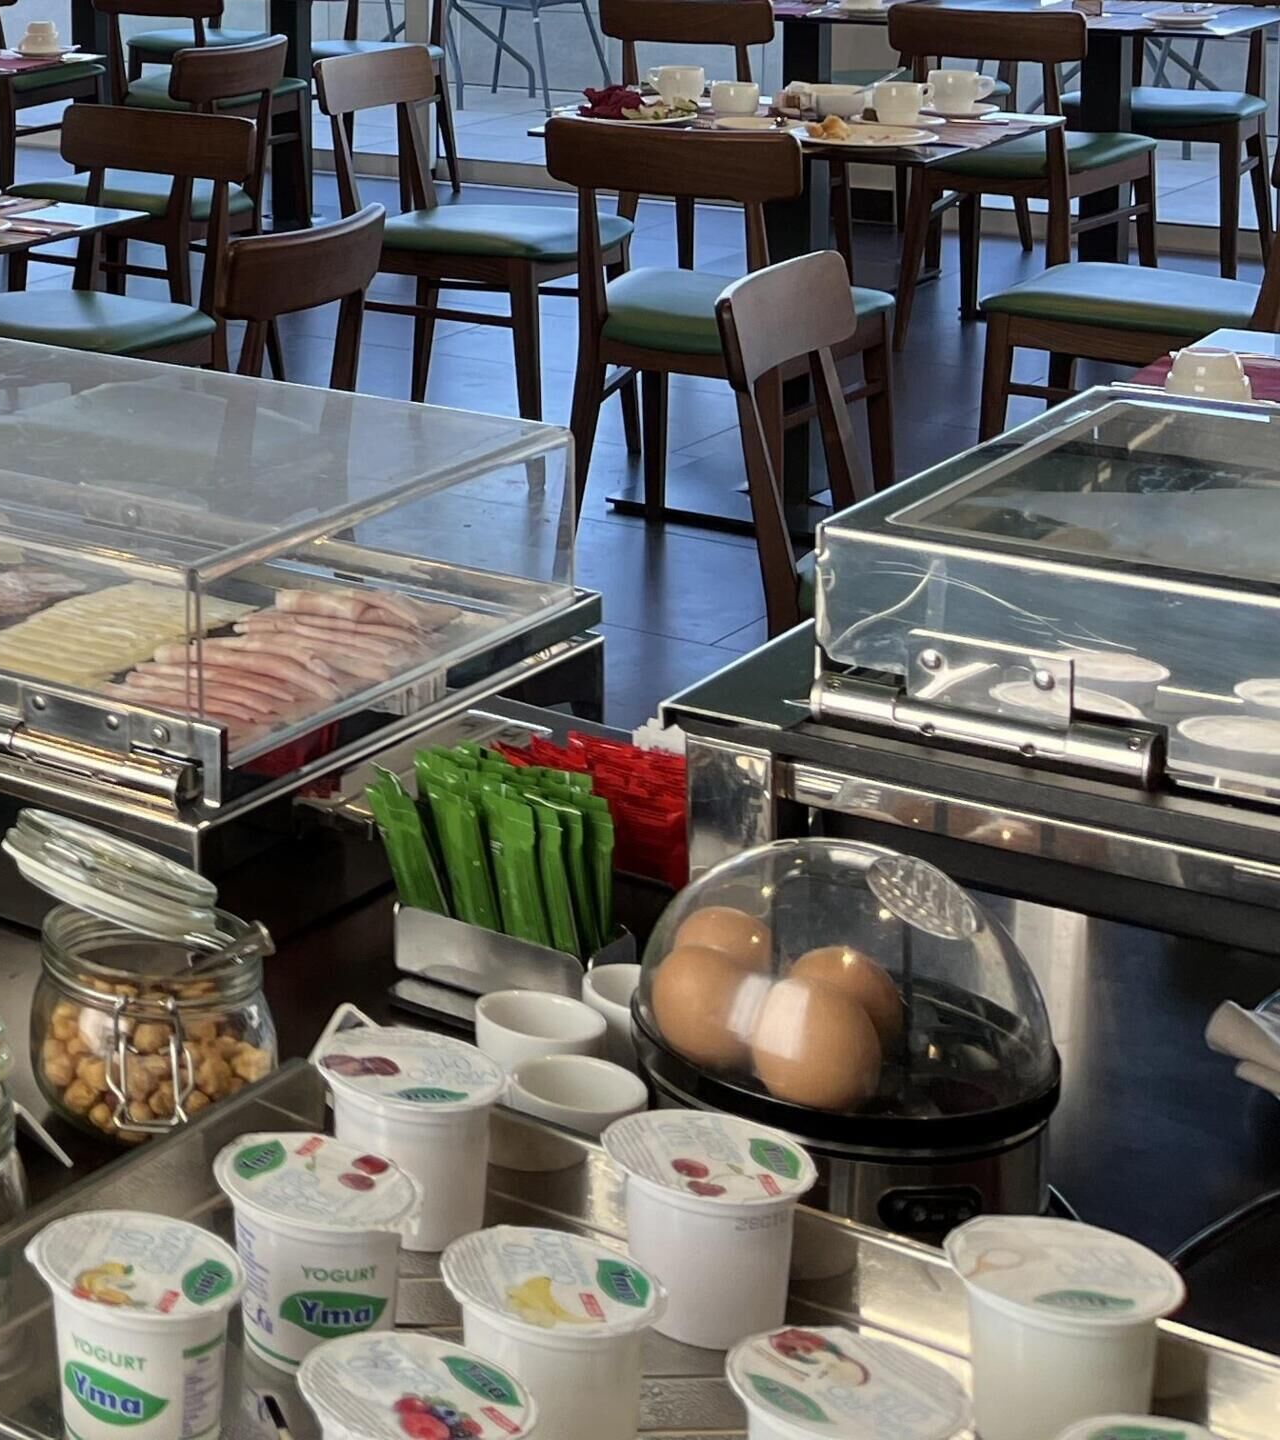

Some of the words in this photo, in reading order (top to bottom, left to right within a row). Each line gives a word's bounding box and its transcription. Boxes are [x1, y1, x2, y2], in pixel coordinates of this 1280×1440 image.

[301, 1264, 378, 1283] YOGURT
[296, 1297, 373, 1329] Yma
[71, 1332, 147, 1371] YOGURT
[71, 1363, 144, 1420] Yma
